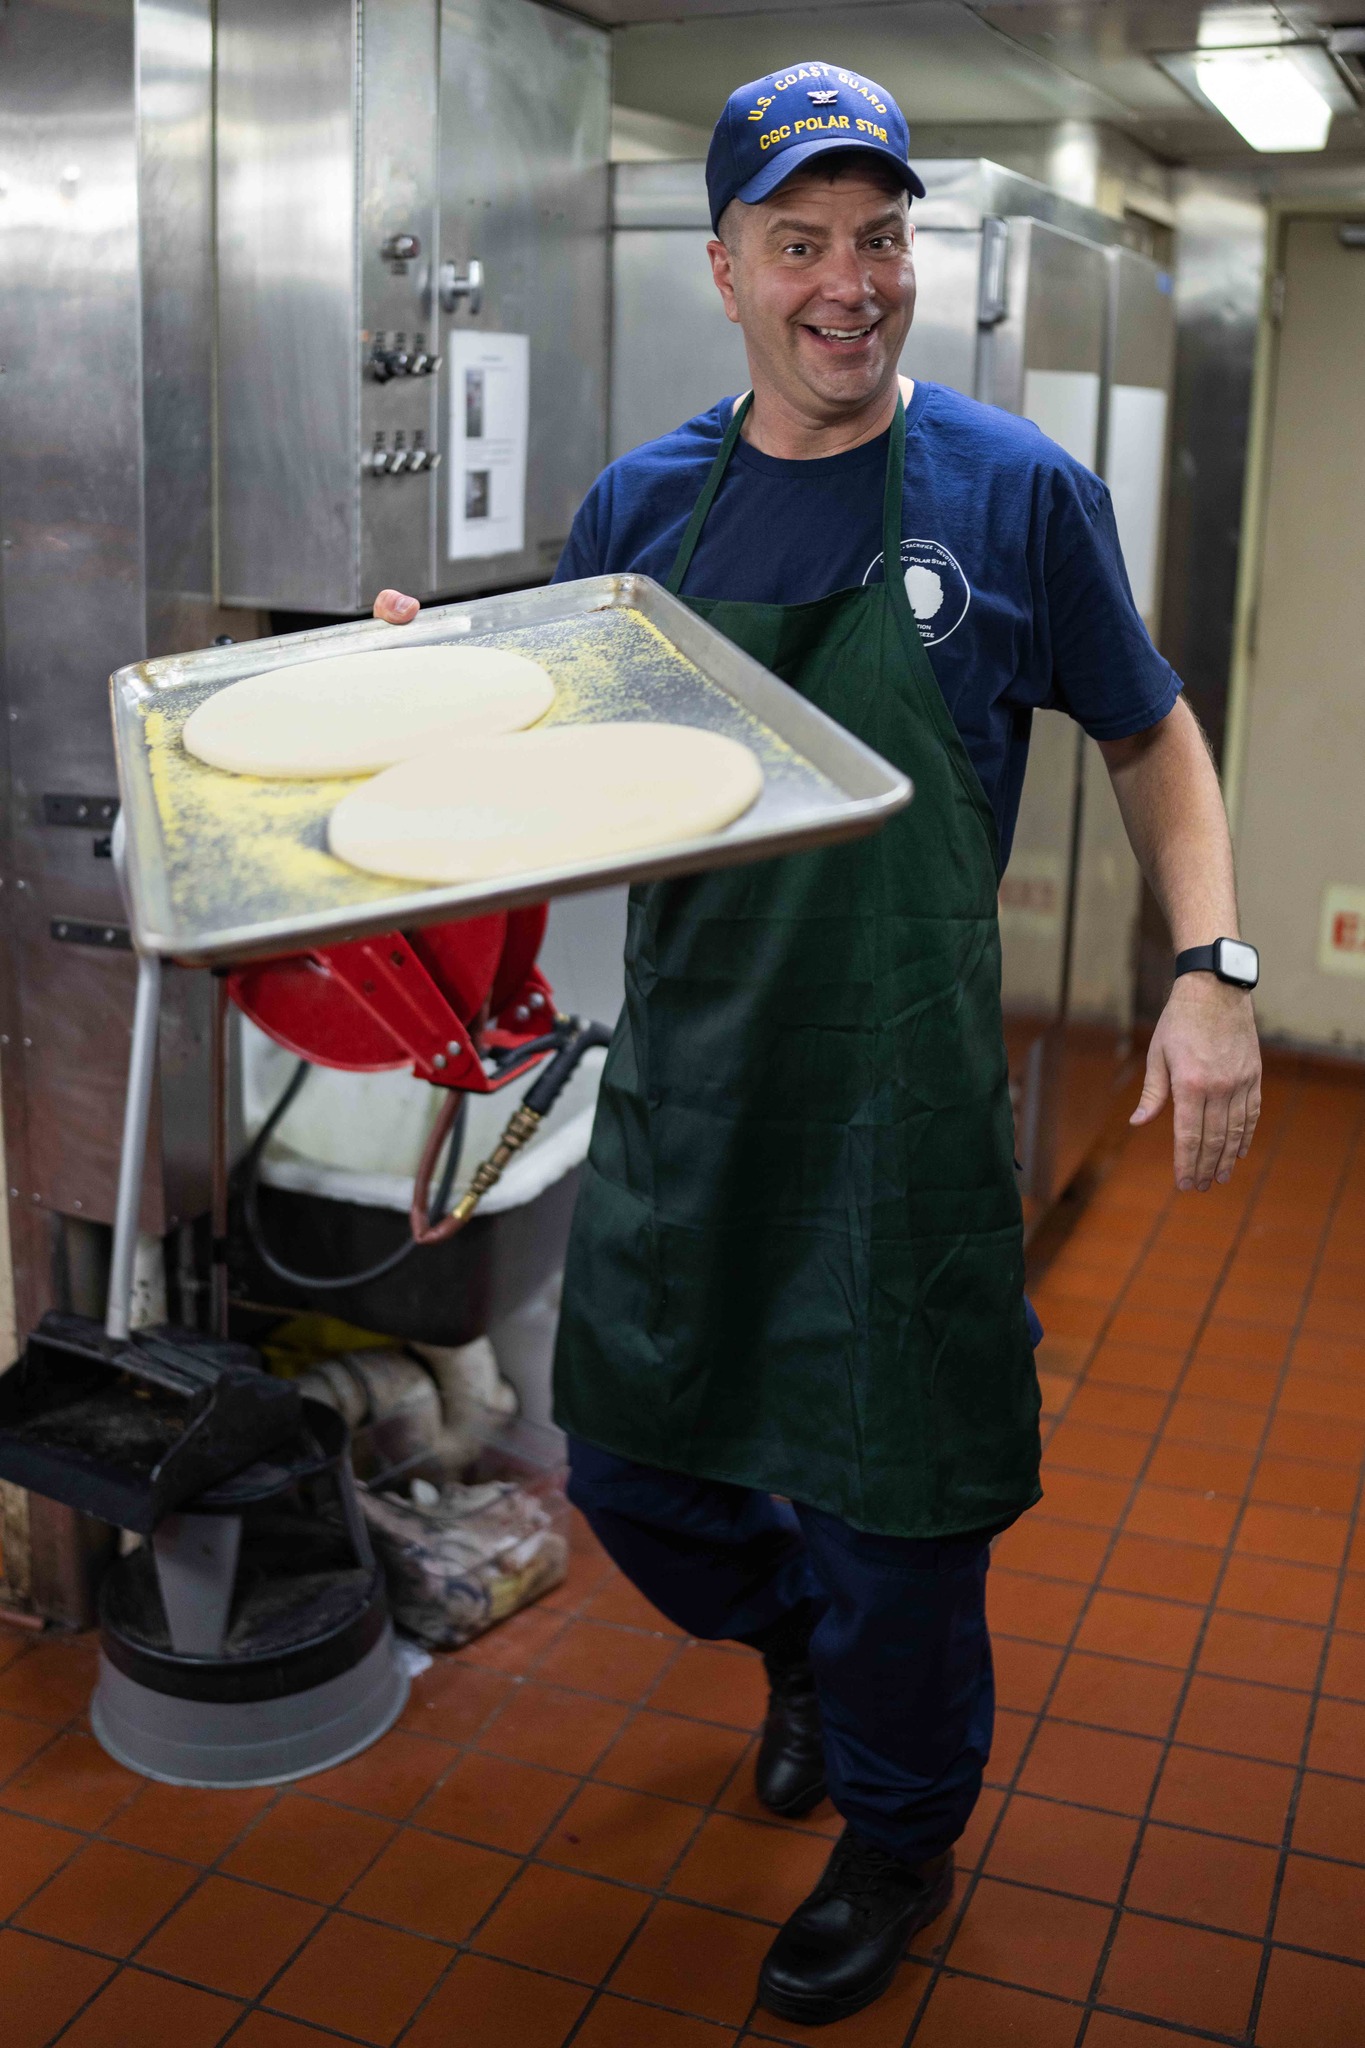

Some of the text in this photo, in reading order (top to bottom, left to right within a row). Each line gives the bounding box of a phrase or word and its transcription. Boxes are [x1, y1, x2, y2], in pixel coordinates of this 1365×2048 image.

[748, 66, 887, 121] U.S. COAST GUARD
[760, 115, 889, 150] CGC POLAR STAR
[909, 556, 931, 564] POLAR
[931, 558, 947, 566] STAR
[936, 549, 956, 570] DEVOTION
